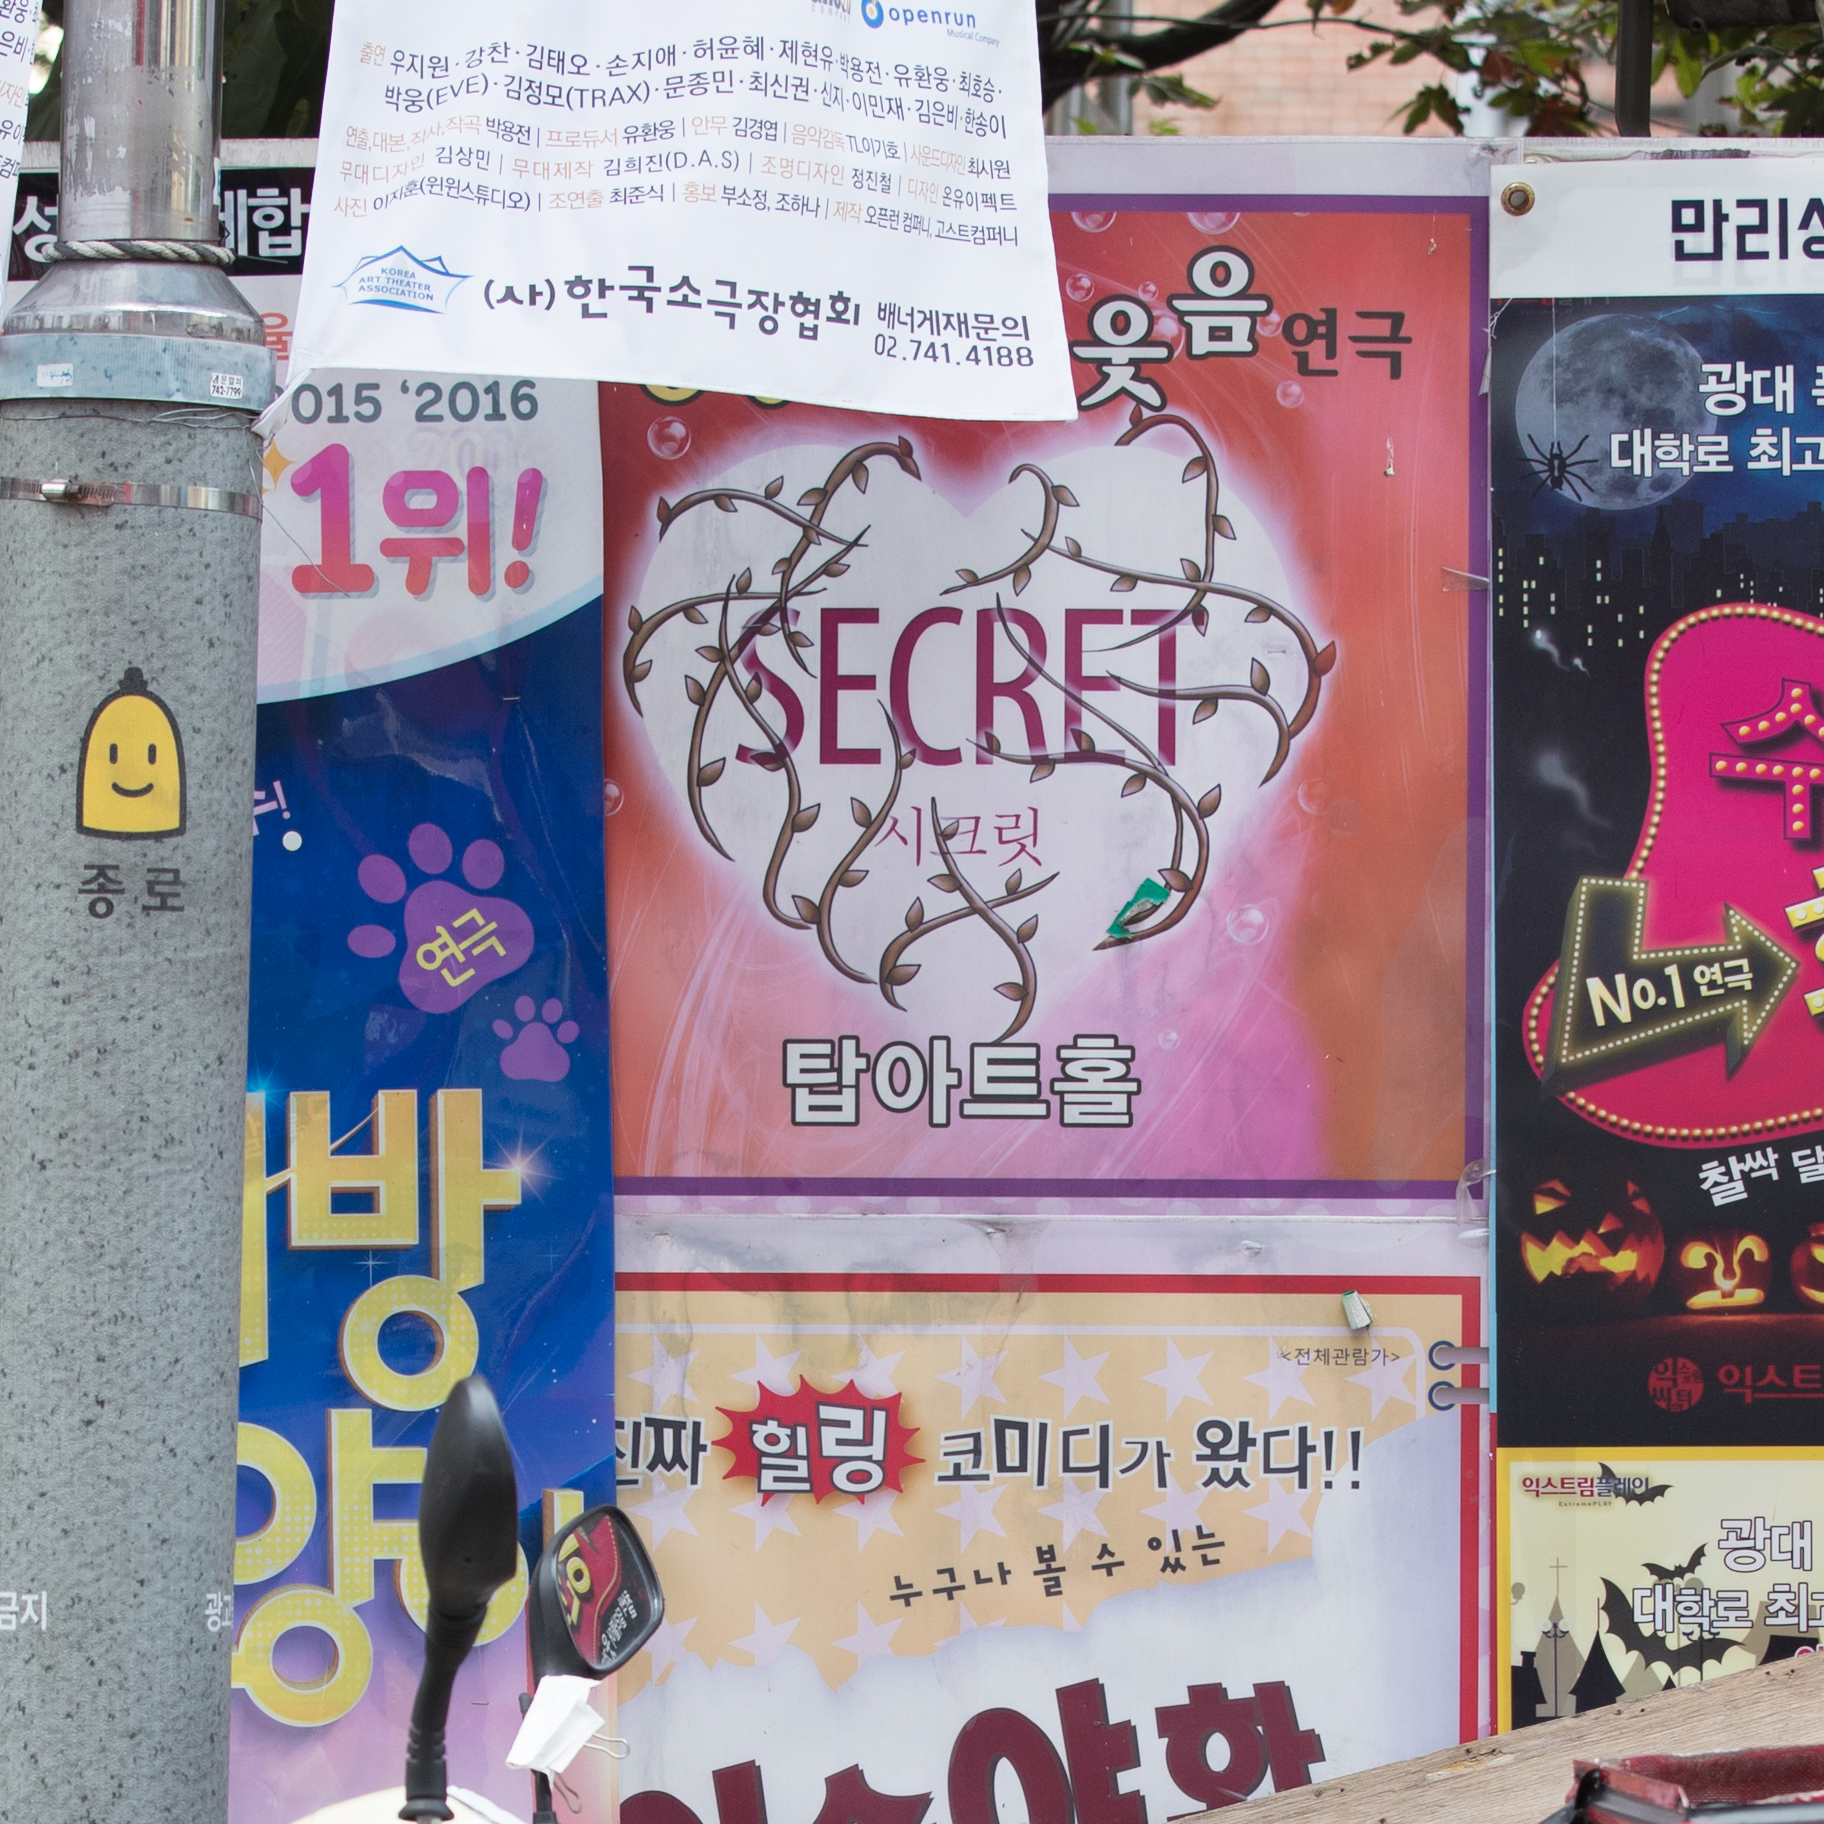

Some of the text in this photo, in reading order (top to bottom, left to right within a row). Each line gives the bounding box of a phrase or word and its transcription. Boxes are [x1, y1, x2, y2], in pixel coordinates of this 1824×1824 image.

[889, 7, 977, 28] openrun
[947, 28, 1000, 49] Musical Company
[361, 42, 386, 66] 출연
[390, 50, 450, 79] 우지원
[465, 41, 511, 68] 강찬
[526, 44, 590, 76] 김태오
[606, 45, 676, 77] 손지애
[693, 35, 764, 62] 허윤혜
[385, 72, 488, 113] 박웅(EVE)
[503, 74, 650, 111] 김정모(TRAX)
[664, 69, 733, 99] 문종민
[749, 70, 809, 102] 최신권
[486, 117, 531, 147] 박용전
[546, 128, 618, 148] 프로듀서
[622, 120, 676, 144] 유환웅
[692, 115, 728, 136] 안무
[733, 116, 778, 141] 김경엽
[791, 123, 845, 152] 음악감독
[968, 155, 1011, 179] 최시원
[333, 196, 367, 218] 사진
[548, 189, 603, 210] 조연출
[610, 184, 664, 205] 최준식
[682, 181, 717, 203] 홍보
[775, 191, 821, 219] 조하나
[833, 200, 862, 223] 제작
[435, 147, 491, 171] 김상민
[852, 168, 891, 194] 정진철
[908, 179, 939, 204] 디자인
[358, 275, 431, 292] ART THEATER
[358, 284, 434, 302] ASSOCIATION
[381, 267, 416, 280] KOREA
[484, 265, 861, 341] (사) 한국소극장협회
[877, 301, 1031, 342] 배너게재문의
[1070, 244, 1413, 411] 웃음 연극
[874, 333, 1035, 367] 02.741.4188
[293, 383, 383, 424] 015
[1698, 362, 1795, 416] 광대
[1609, 426, 1734, 478] 대학로
[289, 443, 544, 598] 1위!
[735, 607, 1206, 768] SECRET
[874, 805, 1042, 868] 시크릿
[77, 864, 186, 919] 종로
[415, 907, 508, 987] 연극
[1586, 957, 1755, 1028] No.1 연극
[783, 1034, 1141, 1128] 탑아트홀
[1698, 1145, 1779, 1207] 찰싹
[749, 1402, 888, 1495] 힐링
[935, 1414, 1174, 1493] 코미디가
[1193, 1415, 1364, 1494] 왔다!!
[1522, 1476, 1650, 1499] 익스트림플레이
[888, 1525, 1227, 1608] 누구나 볼 수 있는
[1718, 1516, 1813, 1573] 광대
[1633, 1582, 1754, 1634] 대학로
